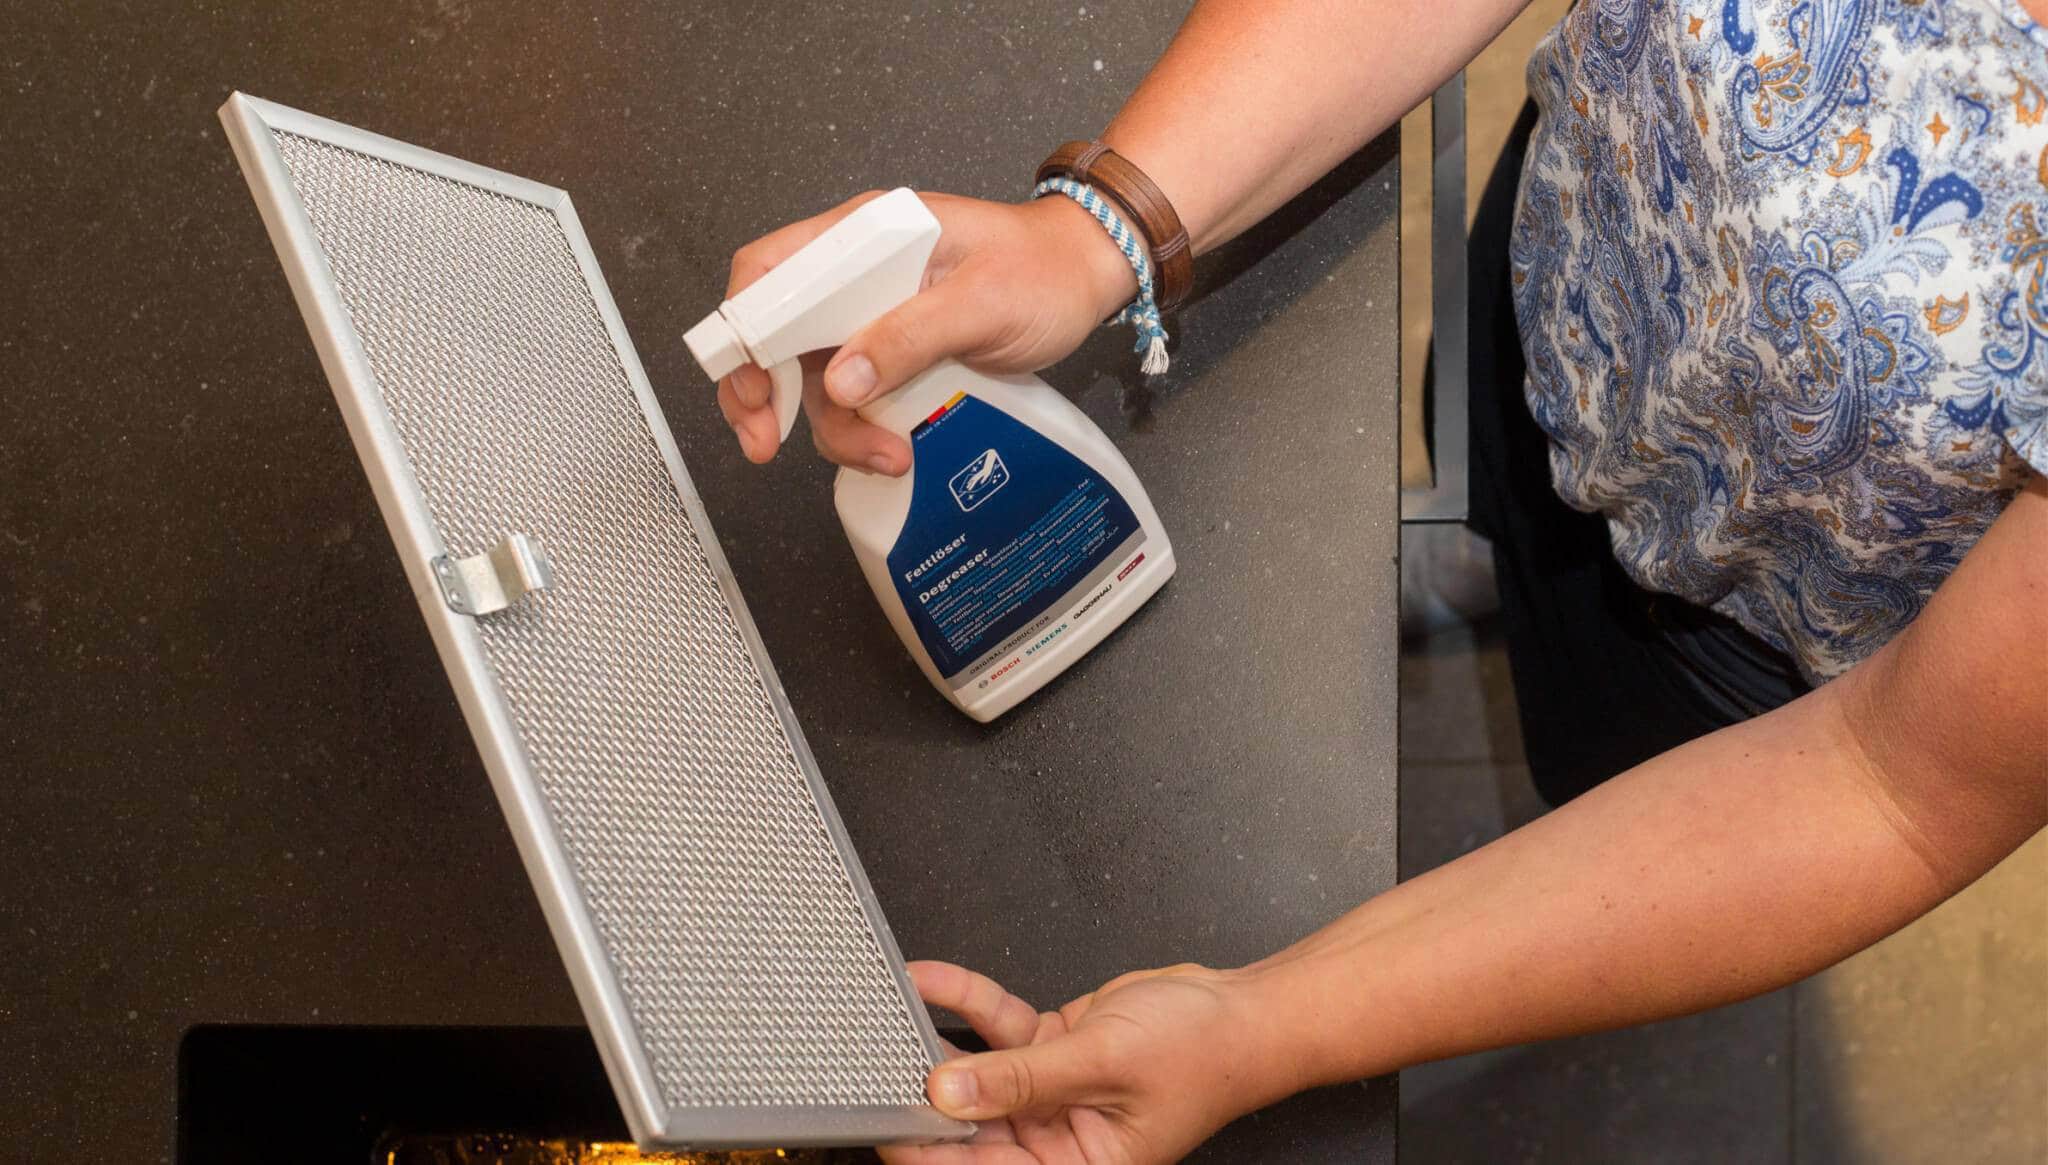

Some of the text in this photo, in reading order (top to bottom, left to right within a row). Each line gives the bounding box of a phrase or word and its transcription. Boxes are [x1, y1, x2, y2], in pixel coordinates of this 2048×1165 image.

[916, 426, 933, 441] MADE
[941, 398, 967, 422] GERMANY
[904, 532, 966, 583] Fettlöser
[918, 547, 988, 604] Degreaser
[969, 650, 1002, 675] ORIGINAL
[1002, 626, 1035, 652] PRODUCT
[1034, 615, 1050, 628] FOR
[989, 656, 1021, 681] BOSCH
[1025, 623, 1068, 656] SIEMENS
